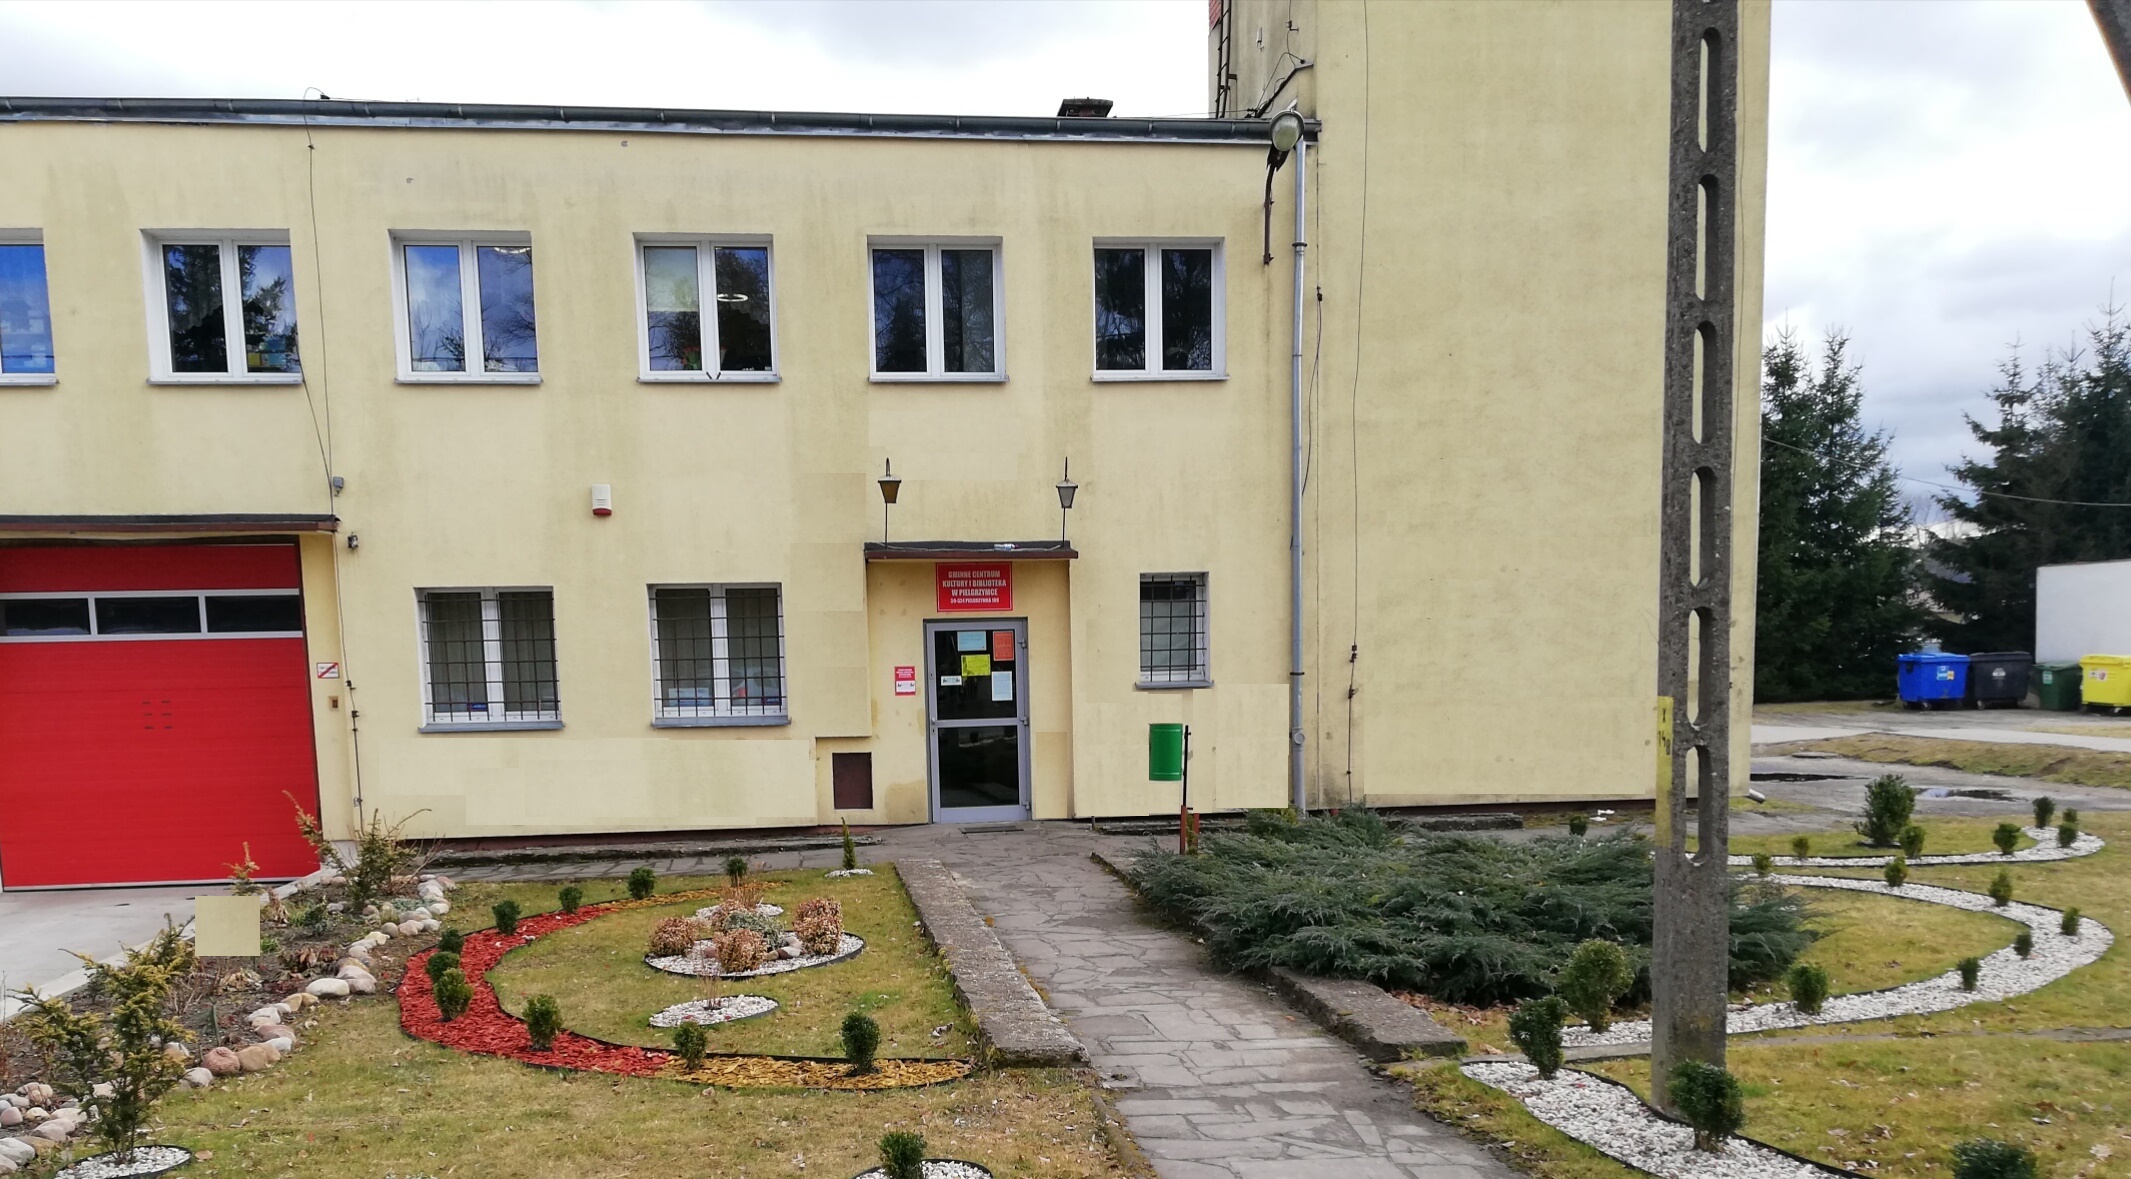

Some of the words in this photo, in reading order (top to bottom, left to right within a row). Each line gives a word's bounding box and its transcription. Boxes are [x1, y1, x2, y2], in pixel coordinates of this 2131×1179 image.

[948, 570, 971, 578] GMINNE
[972, 570, 1000, 578] CENTRUM
[972, 579, 1007, 587] BIBLIOTEKA
[959, 588, 998, 596] PIELGRZYMCE
